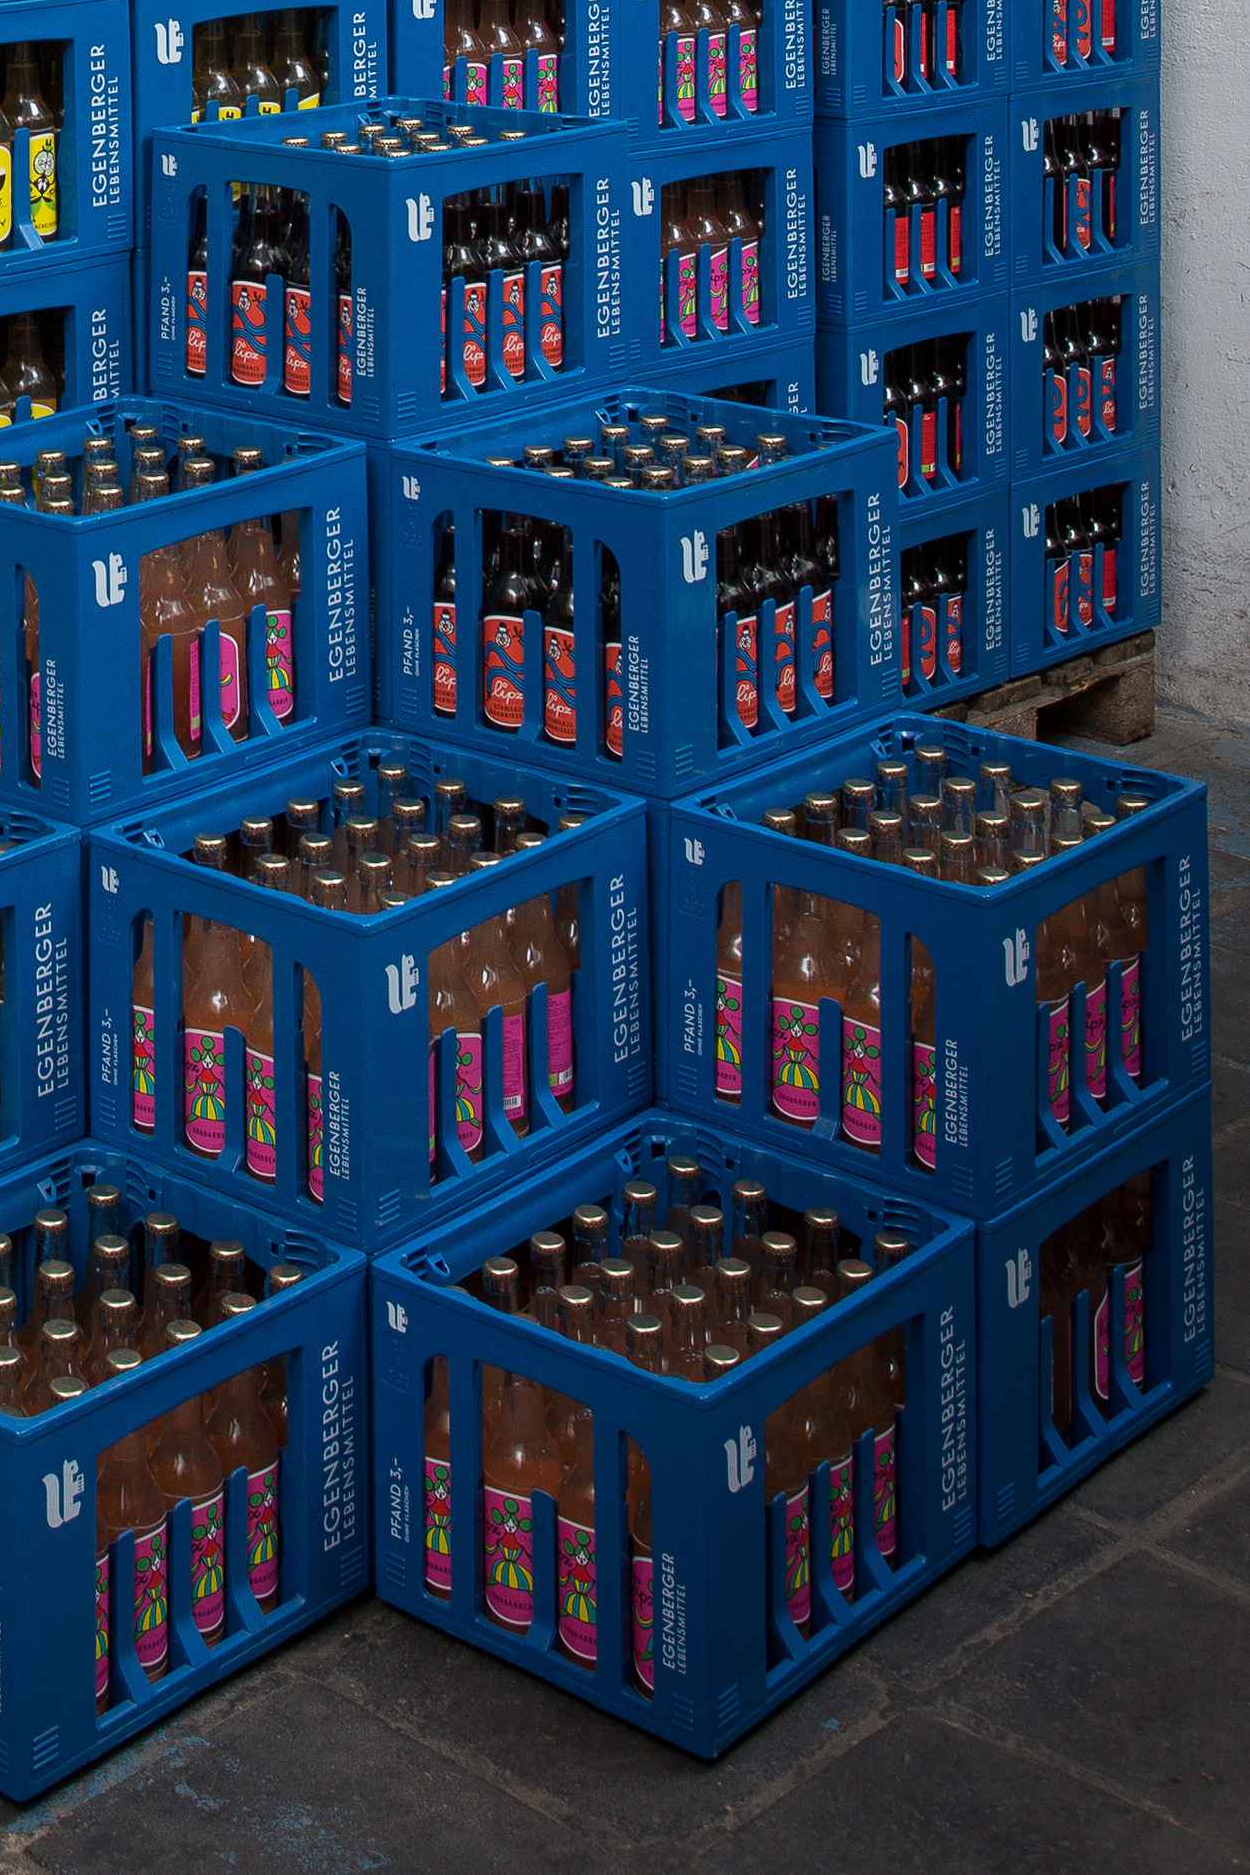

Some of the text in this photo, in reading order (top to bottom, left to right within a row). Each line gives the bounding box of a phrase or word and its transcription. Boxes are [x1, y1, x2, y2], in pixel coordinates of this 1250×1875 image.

[601, 7, 610, 115] LEBENSMITTEL
[91, 45, 107, 206] EGENBERGER
[108, 77, 119, 203] LEBENSMITTEL
[1140, 110, 1148, 224] EGENBERGER
[787, 169, 797, 298] EGENBERGER
[798, 195, 806, 296] LEBENSMITTEL
[985, 135, 993, 256] EGENBERGER
[597, 179, 610, 337] EGENBERGER
[611, 210, 620, 334] LEBENSMITTEL
[188, 330, 207, 353] lip
[357, 288, 366, 375] EGENBERGER
[1139, 295, 1147, 409] EGENBERGER
[986, 333, 995, 455] EGENBERGER
[326, 507, 343, 682] EGENBERGER
[868, 493, 882, 665] EGENBERGER
[882, 526, 892, 660] LEBENSMITTEL
[986, 529, 994, 650] EGENBERGER
[1141, 482, 1149, 596] EGENBERGER
[344, 540, 356, 676] LEBENSMITTEL
[404, 629, 412, 675] PFAND
[47, 660, 56, 756] EGENBERGER
[436, 666, 456, 690] lip
[629, 636, 639, 731] EGENBERGER
[35, 903, 54, 1097] EGENBERGER
[610, 875, 628, 1063] EGENBERGER
[628, 908, 640, 1054] LEBENSMITTEL
[1180, 855, 1192, 1041] EGENBERGER
[1192, 889, 1202, 1033] LEBENSMITTEL
[56, 938, 68, 1088] LEBENSMITTEL
[102, 1033, 110, 1083] PFAND
[684, 1004, 694, 1053] PFAND
[329, 1071, 340, 1176] EGENBERGER
[945, 1040, 957, 1143] EGENBERGER
[1183, 1155, 1195, 1342] EGENBERGER
[322, 1341, 340, 1551] EGENBERGER
[342, 1376, 354, 1539] LEBENSMITTEL
[941, 1306, 955, 1511] EGENBERGER
[956, 1341, 966, 1499] LEBENSMITTEL
[390, 1473, 401, 1539] PFAND
[662, 1553, 675, 1669] EGENBERGER
